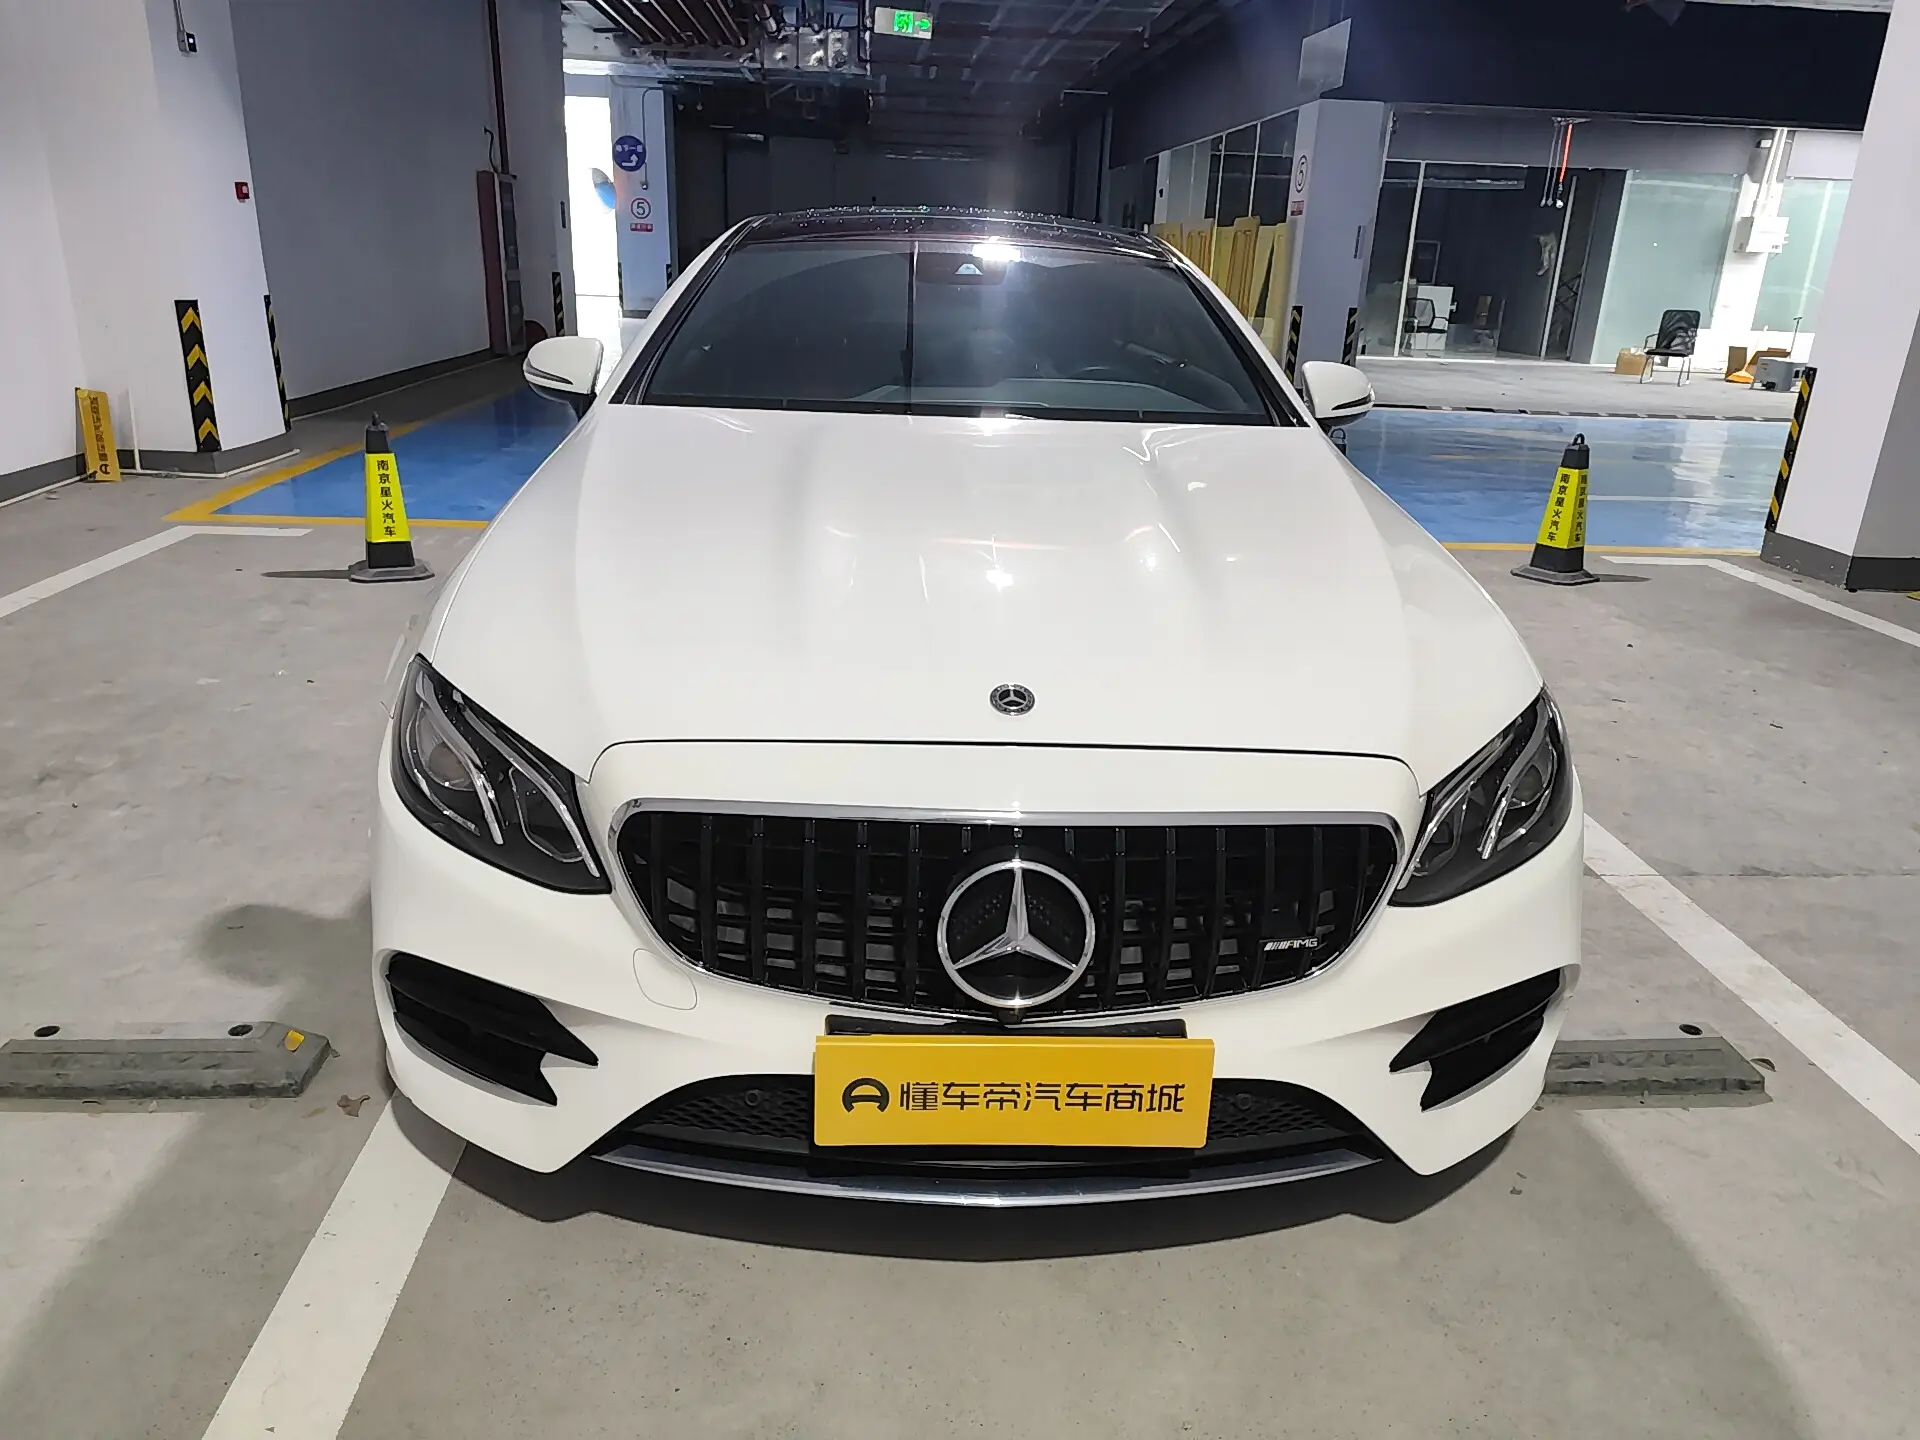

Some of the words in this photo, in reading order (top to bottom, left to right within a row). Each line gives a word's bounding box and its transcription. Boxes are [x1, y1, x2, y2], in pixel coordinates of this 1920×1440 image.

[636, 201, 646, 216] 5
[376, 459, 397, 537] 南京星火汽车
[1546, 473, 1571, 542] 南京星火汽车
[899, 1081, 1185, 1113] 懂车帝汽车商城
